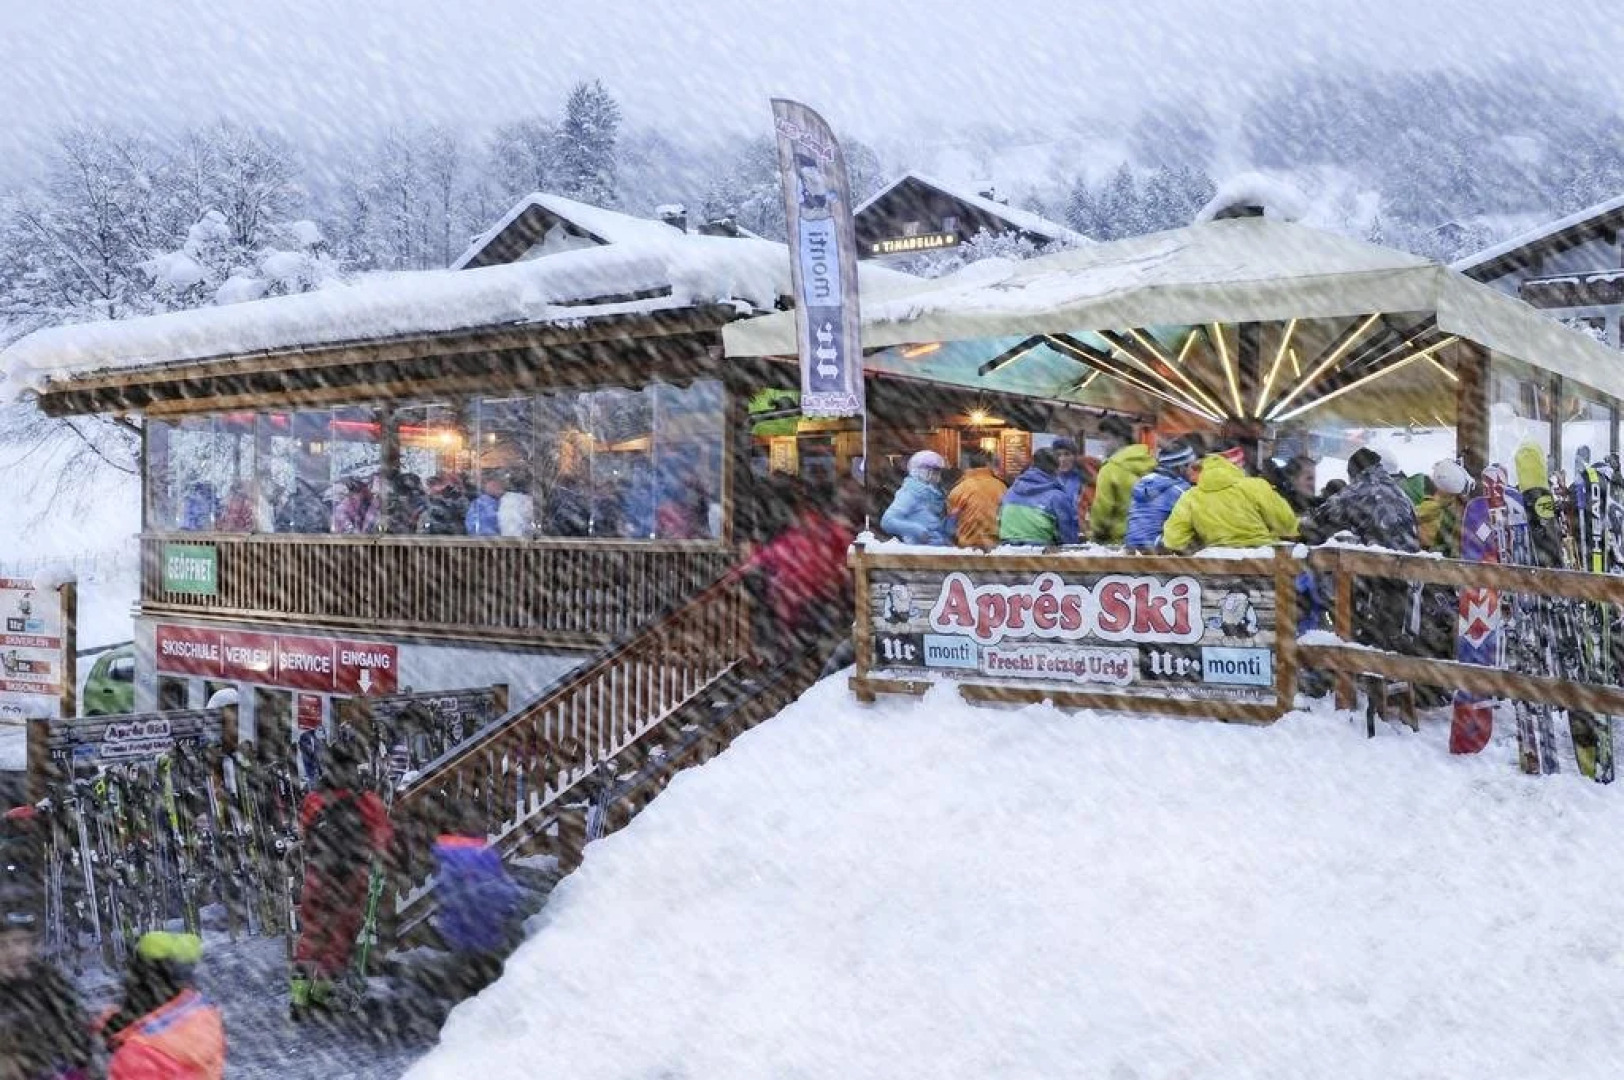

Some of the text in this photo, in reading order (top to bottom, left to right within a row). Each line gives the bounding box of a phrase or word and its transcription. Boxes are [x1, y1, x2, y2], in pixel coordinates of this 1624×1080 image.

[1591, 482, 1602, 552] HEAD
[936, 578, 1192, 639] Aprés Ski
[161, 639, 220, 660] SKISCHULE
[280, 652, 330, 673] SERVICE
[341, 651, 390, 669] EINGANG
[928, 643, 970, 661] monti
[1207, 656, 1261, 676] monti
